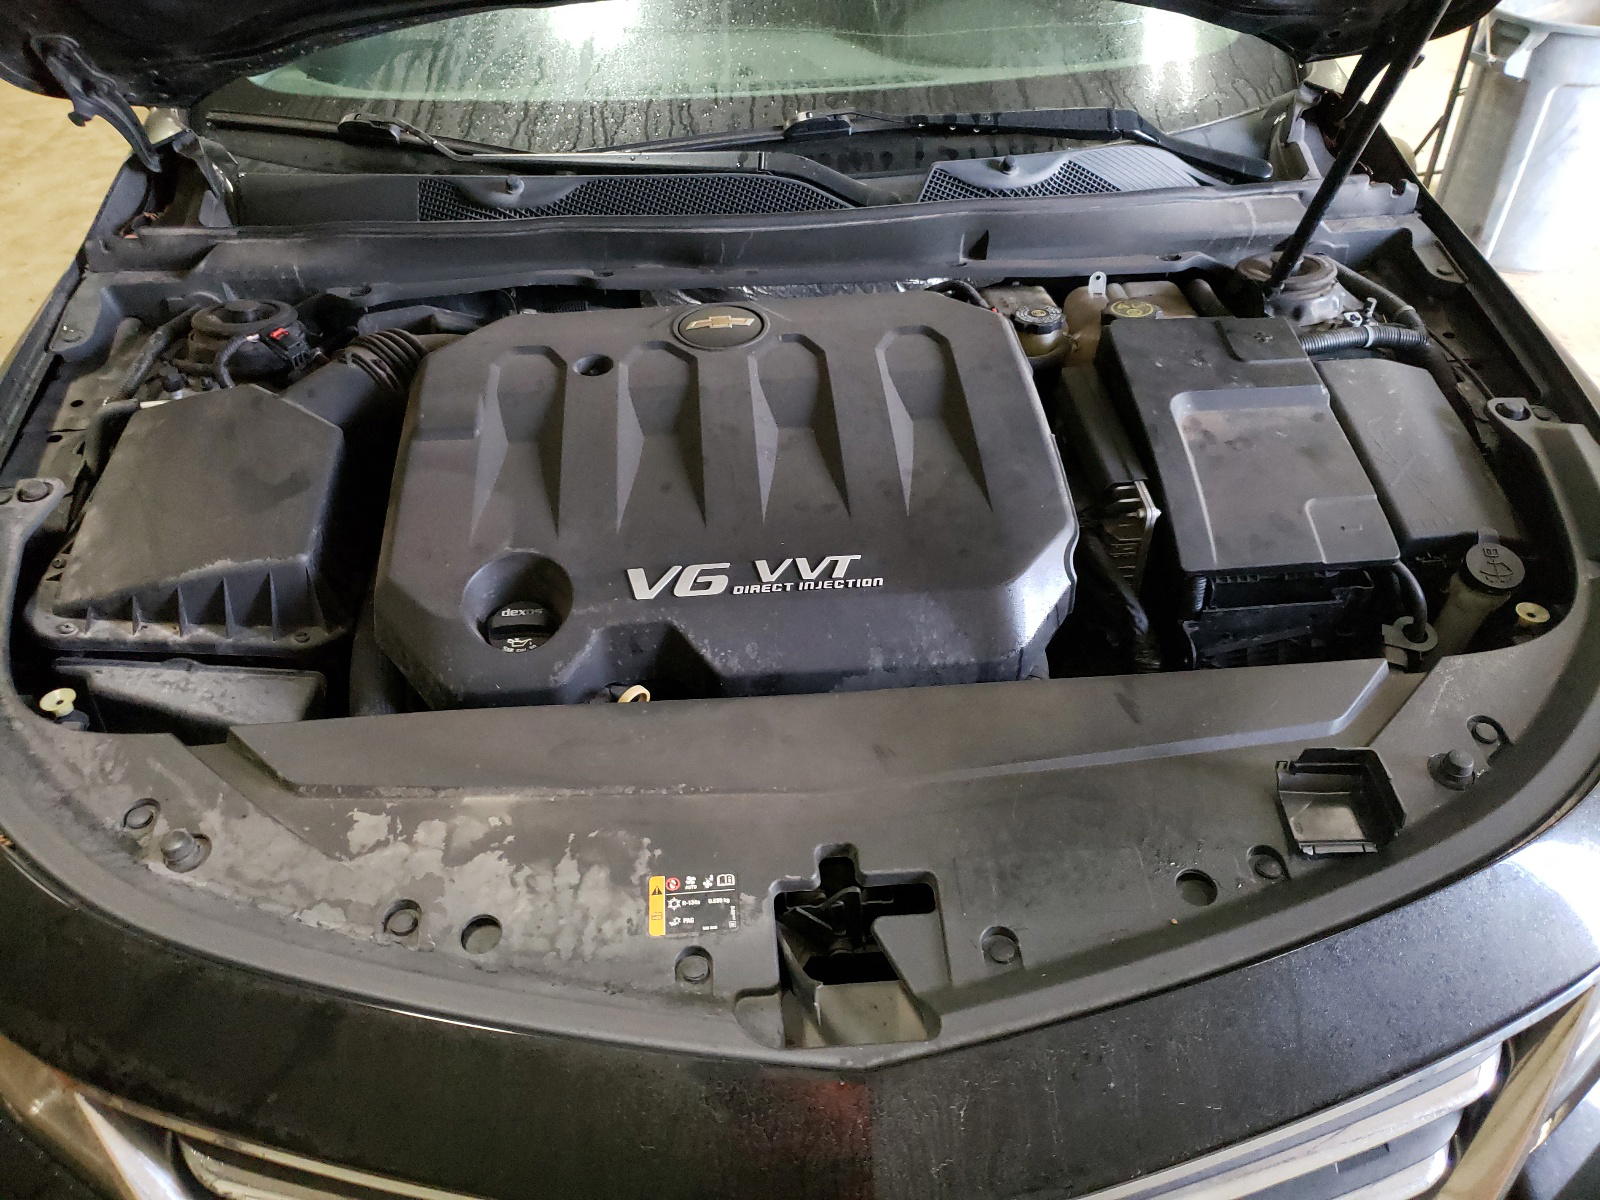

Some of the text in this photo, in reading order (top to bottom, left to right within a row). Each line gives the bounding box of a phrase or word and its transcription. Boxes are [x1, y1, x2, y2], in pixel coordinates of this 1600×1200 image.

[627, 555, 861, 600] V6 VVT
[733, 578, 884, 595] DIRECT INJECTION
[502, 608, 543, 617] dexos
